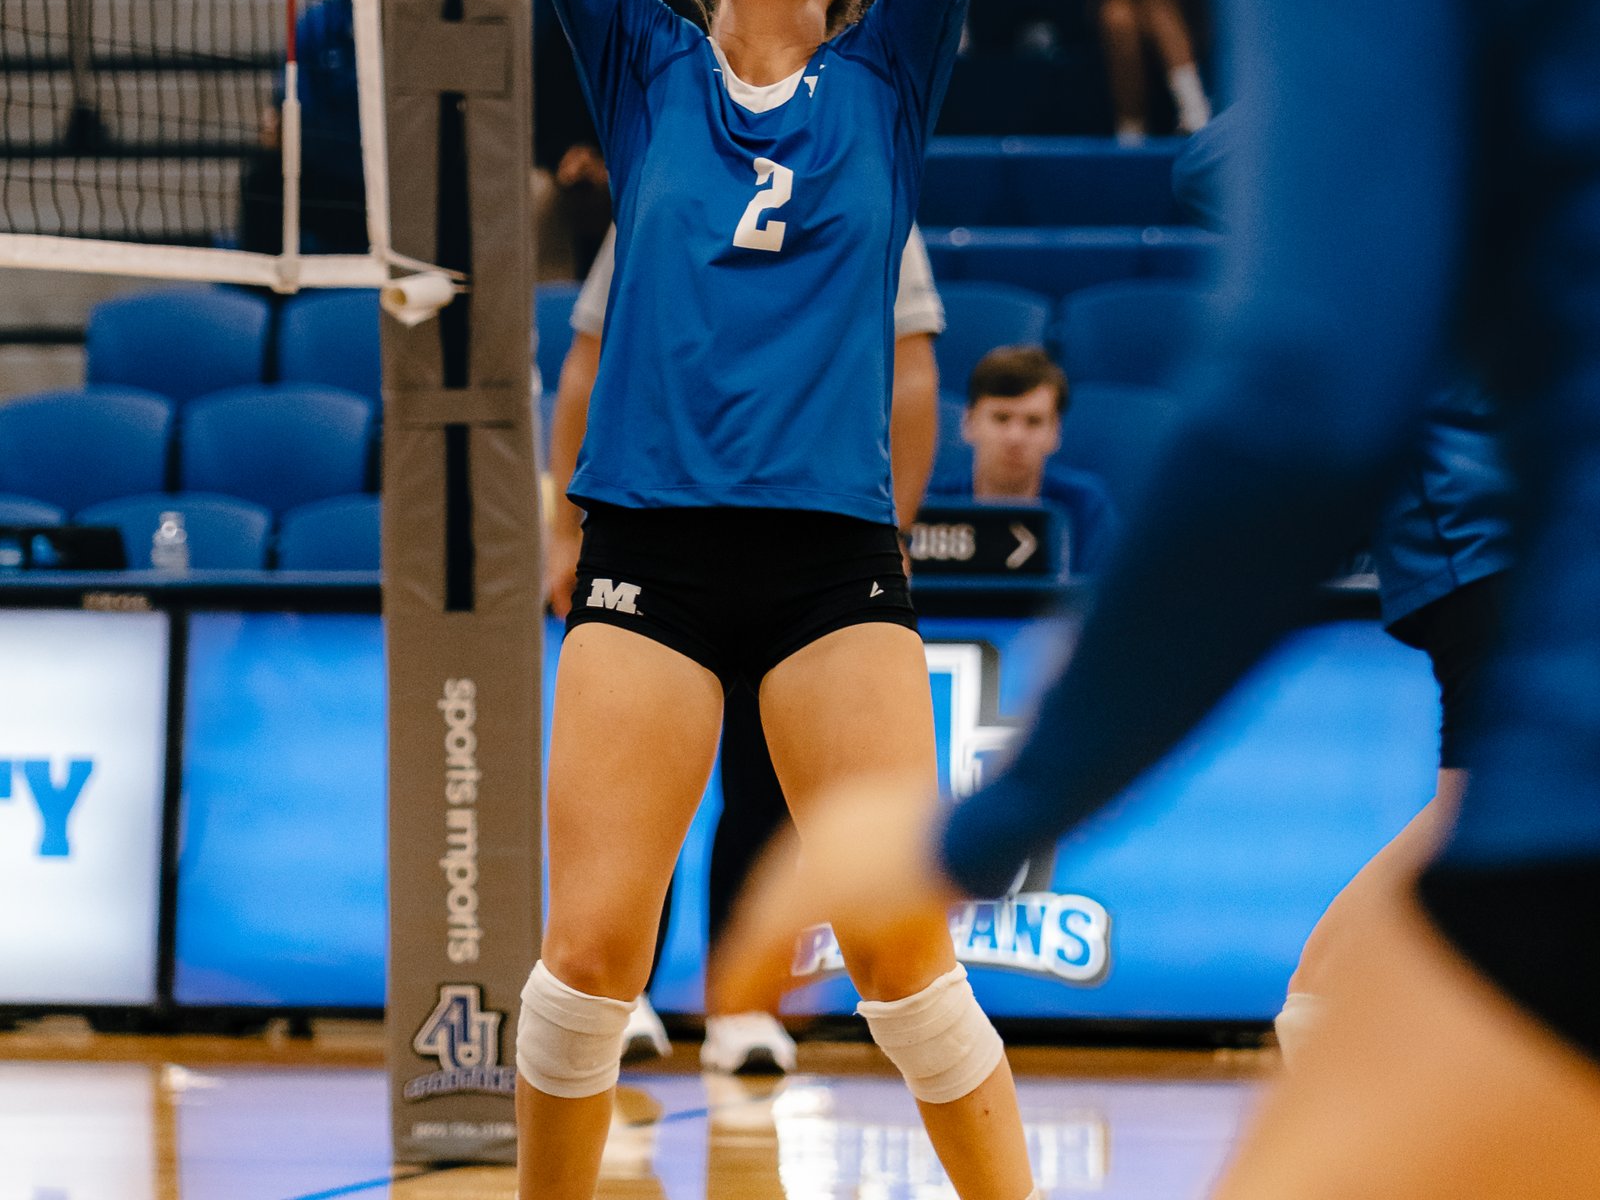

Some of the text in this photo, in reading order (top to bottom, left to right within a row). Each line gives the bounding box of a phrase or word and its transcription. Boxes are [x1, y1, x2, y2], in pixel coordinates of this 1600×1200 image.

[732, 156, 794, 253] 2
[585, 577, 642, 615] M
[440, 678, 482, 964] sports imports
